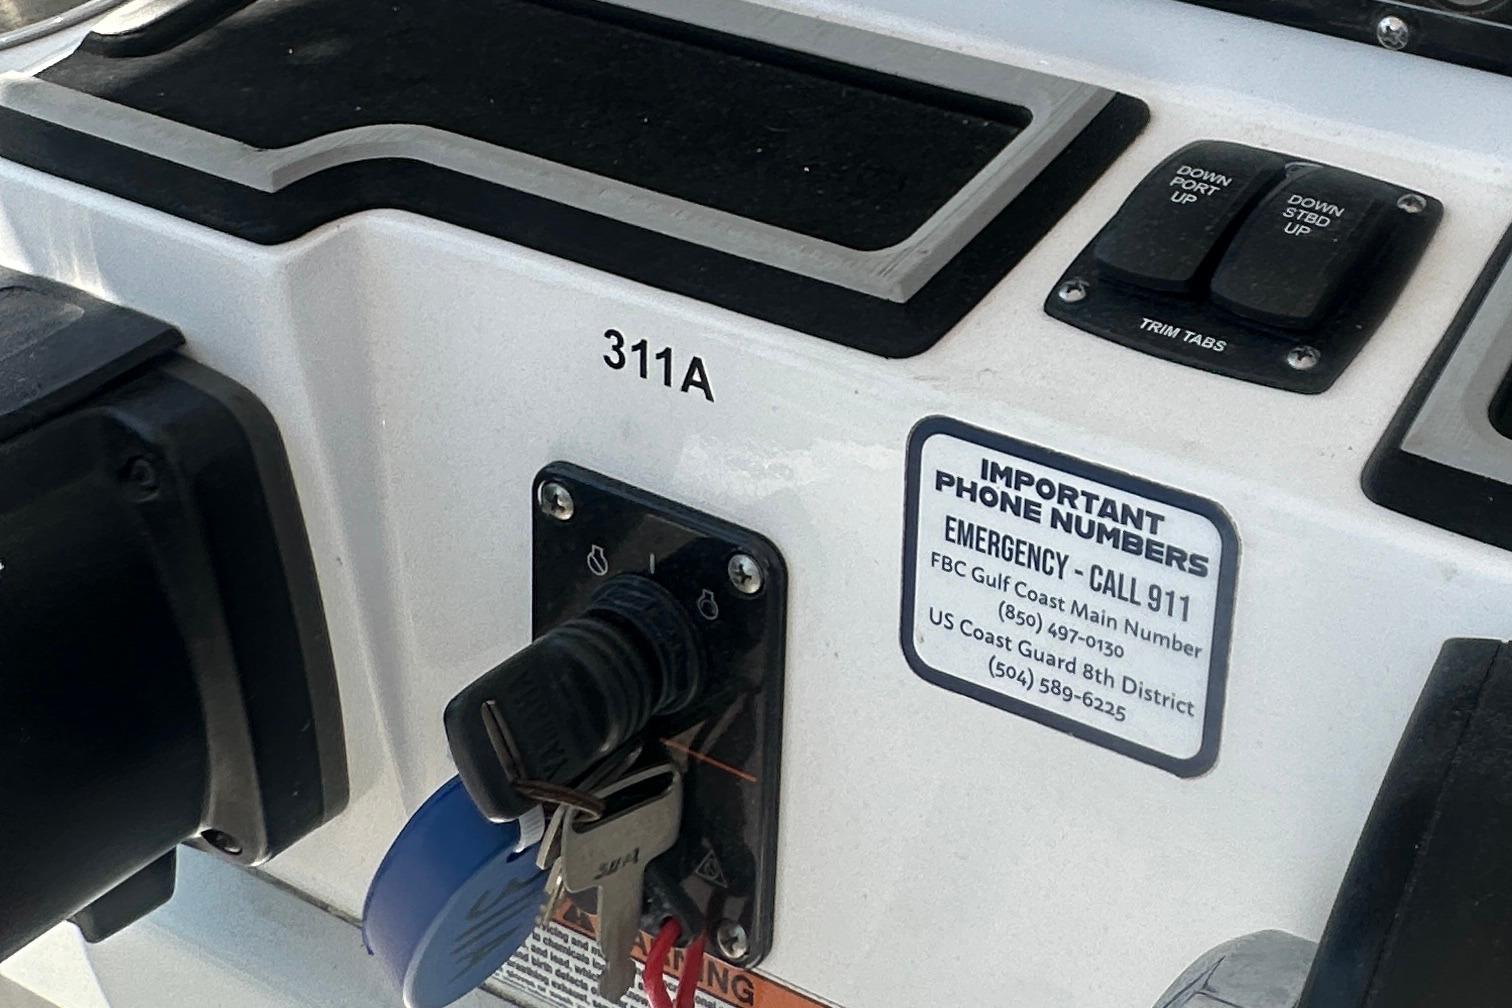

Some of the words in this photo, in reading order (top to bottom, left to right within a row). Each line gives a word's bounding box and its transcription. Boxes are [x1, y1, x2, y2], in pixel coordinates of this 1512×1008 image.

[1169, 176, 1220, 197] PORT
[1170, 191, 1198, 205] UP
[1176, 165, 1232, 187] DOWN
[1287, 194, 1345, 218] DOWN
[1282, 207, 1331, 228] STBD
[1284, 222, 1311, 236] UP
[1140, 317, 1181, 339] TRIM
[1183, 330, 1228, 352] TABS
[603, 328, 714, 403] 311A
[935, 469, 1042, 524] PHONE
[1050, 507, 1209, 578] NUMBERS
[980, 458, 1165, 535] IMPORTANT
[945, 514, 1070, 580] EMERGENCY
[1089, 564, 1141, 607] CALL
[1147, 583, 1190, 622] 911
[930, 551, 967, 578] FBC
[971, 565, 1012, 592] Gulf
[1014, 581, 1065, 612] Coast
[1070, 599, 1118, 630] Main
[1124, 618, 1203, 659] Number
[998, 599, 1043, 635] (850)
[1047, 622, 1125, 659] 497-0130
[929, 606, 954, 630] US
[959, 618, 1012, 652] Coast
[1018, 639, 1077, 675] Guard
[1083, 663, 1115, 689] 8th
[1122, 675, 1195, 717] District
[988, 654, 1034, 691] (504)
[1038, 677, 1127, 722] 589-6225
